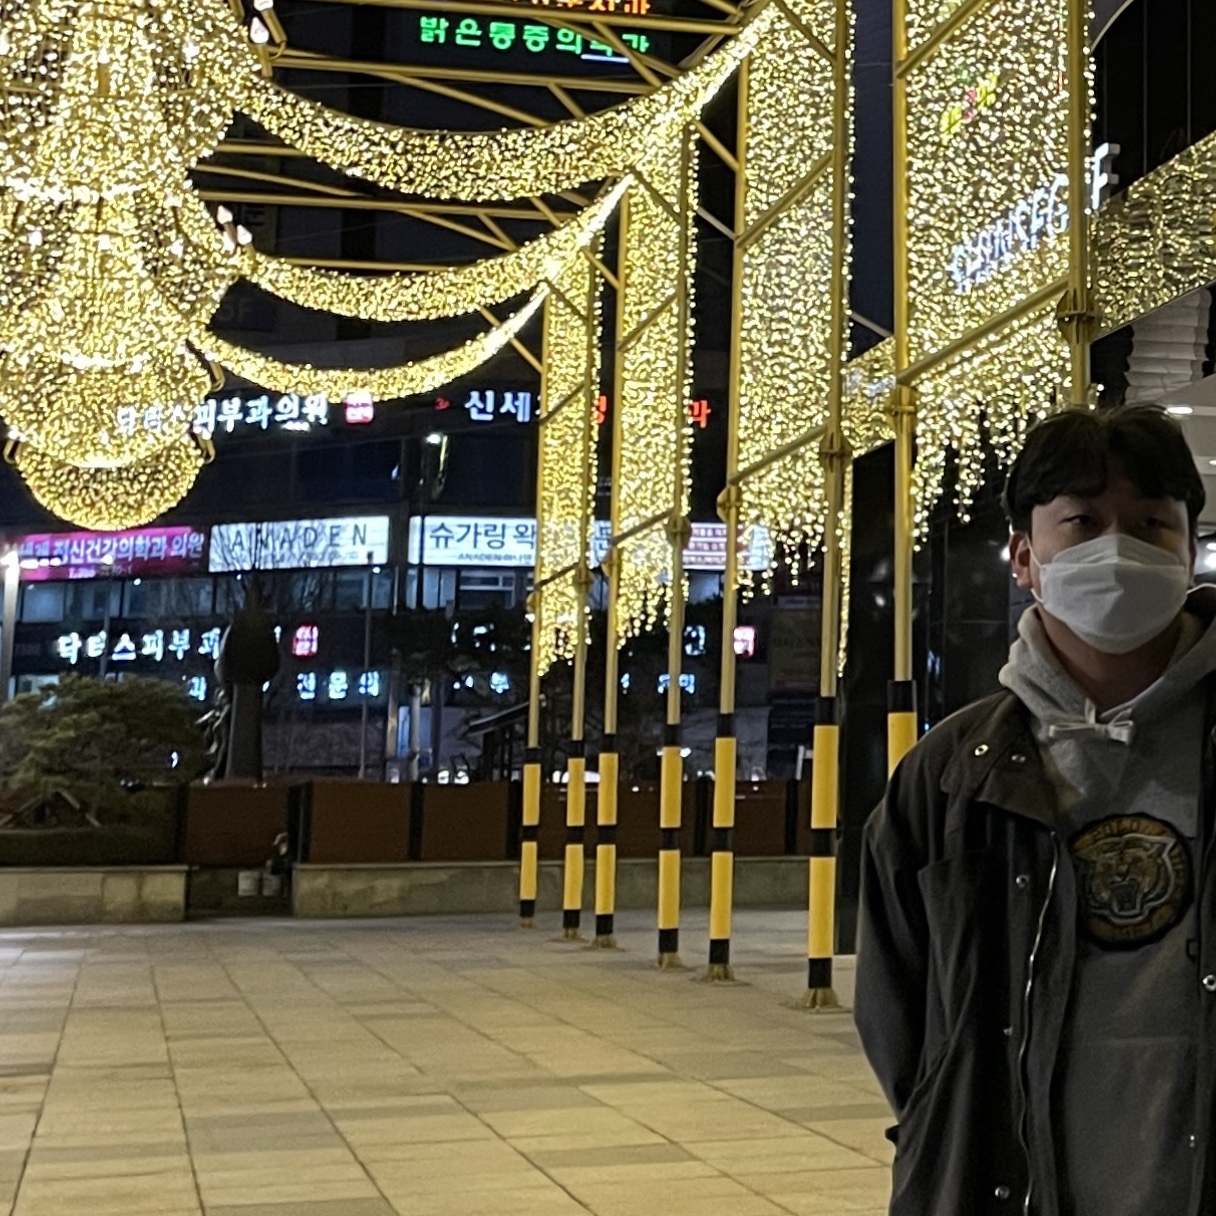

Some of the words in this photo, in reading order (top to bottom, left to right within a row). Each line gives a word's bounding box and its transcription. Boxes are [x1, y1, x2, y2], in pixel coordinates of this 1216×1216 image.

[171, 533, 204, 558] 의원
[231, 523, 367, 552] ANADEN
[429, 522, 506, 551] 슈가링
